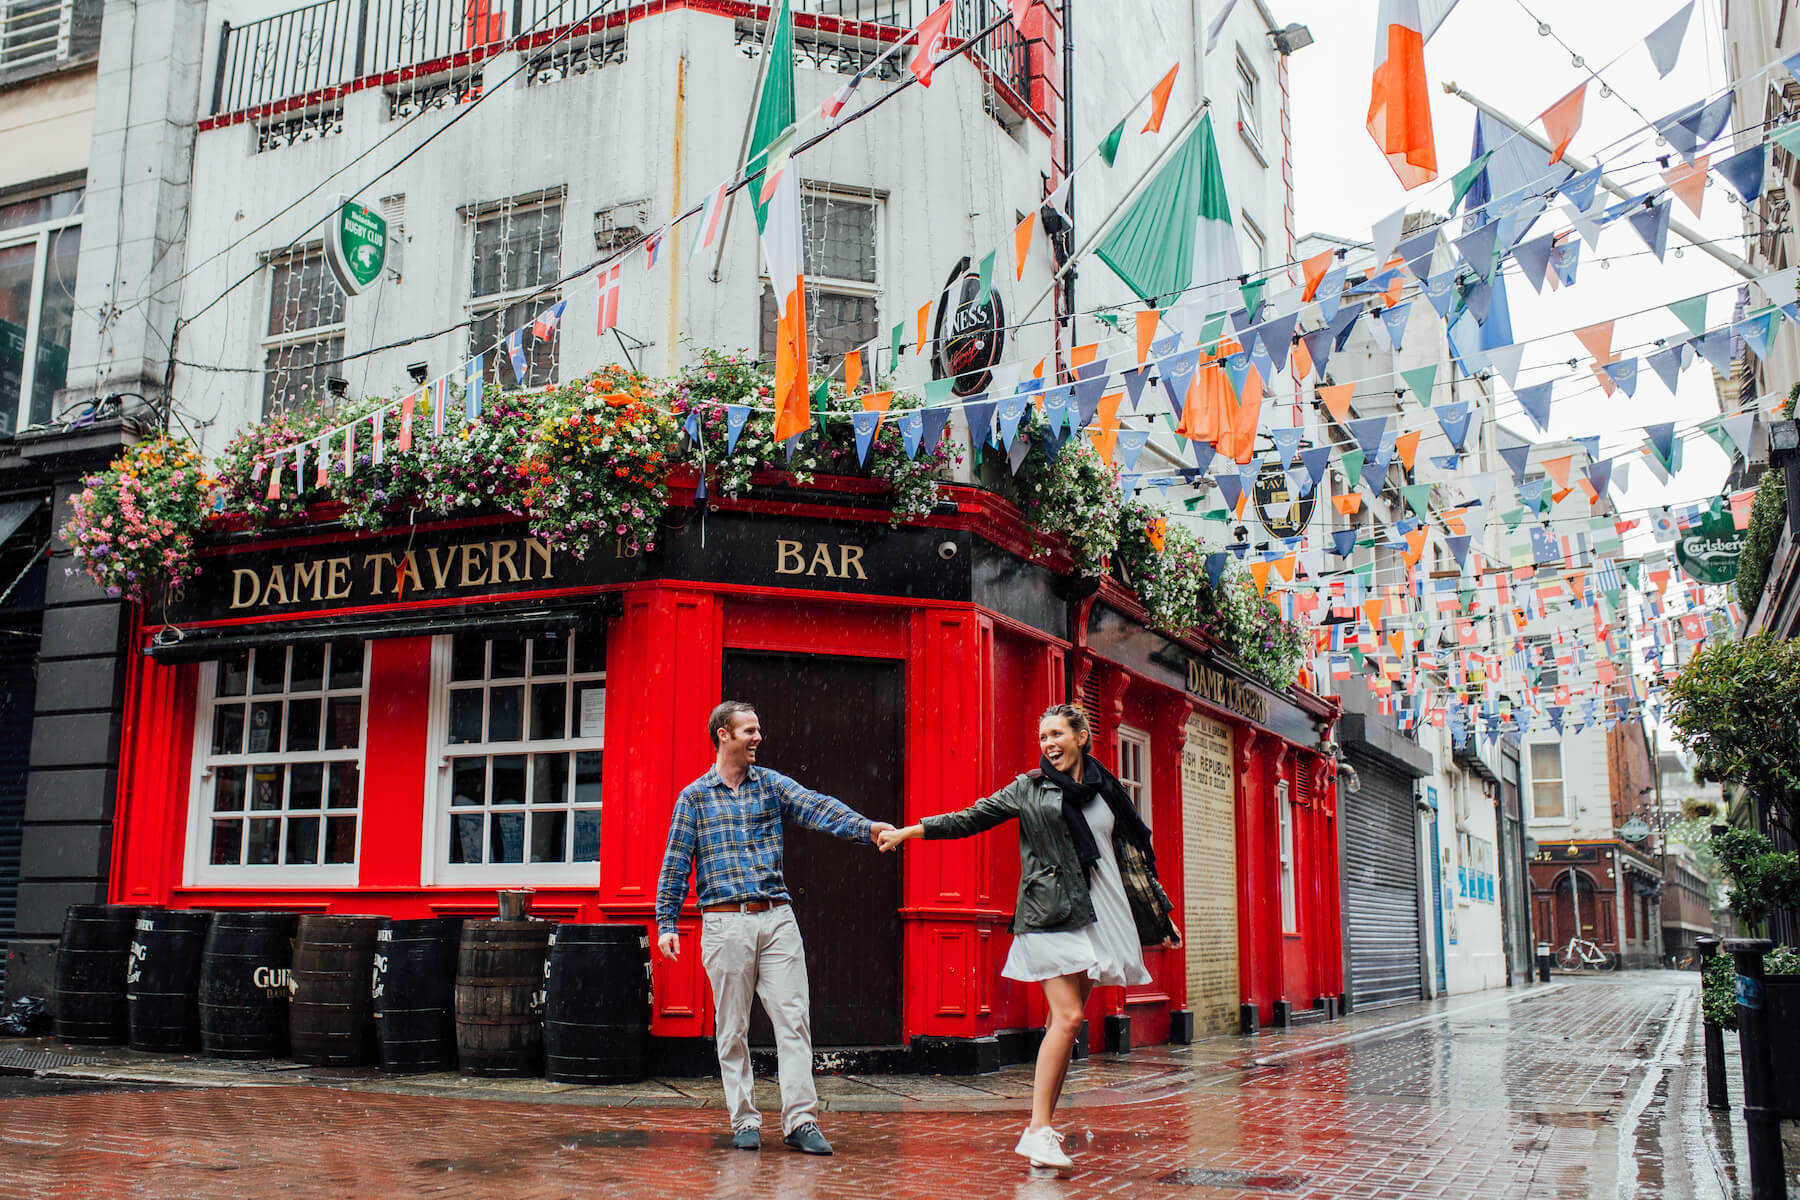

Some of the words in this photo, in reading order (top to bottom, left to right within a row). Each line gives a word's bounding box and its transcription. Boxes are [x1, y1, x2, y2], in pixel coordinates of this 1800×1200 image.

[344, 217, 366, 239] RUGBY
[367, 230, 384, 247] CLUB
[953, 304, 988, 333] NESS
[229, 556, 353, 609] DAME
[363, 537, 554, 596] TAVERN
[615, 532, 639, 559] 18
[775, 539, 868, 580] BAR
[1188, 659, 1226, 703] DAME
[1226, 677, 1267, 723] TAVERN
[1200, 755, 1231, 778] REPUBLIC
